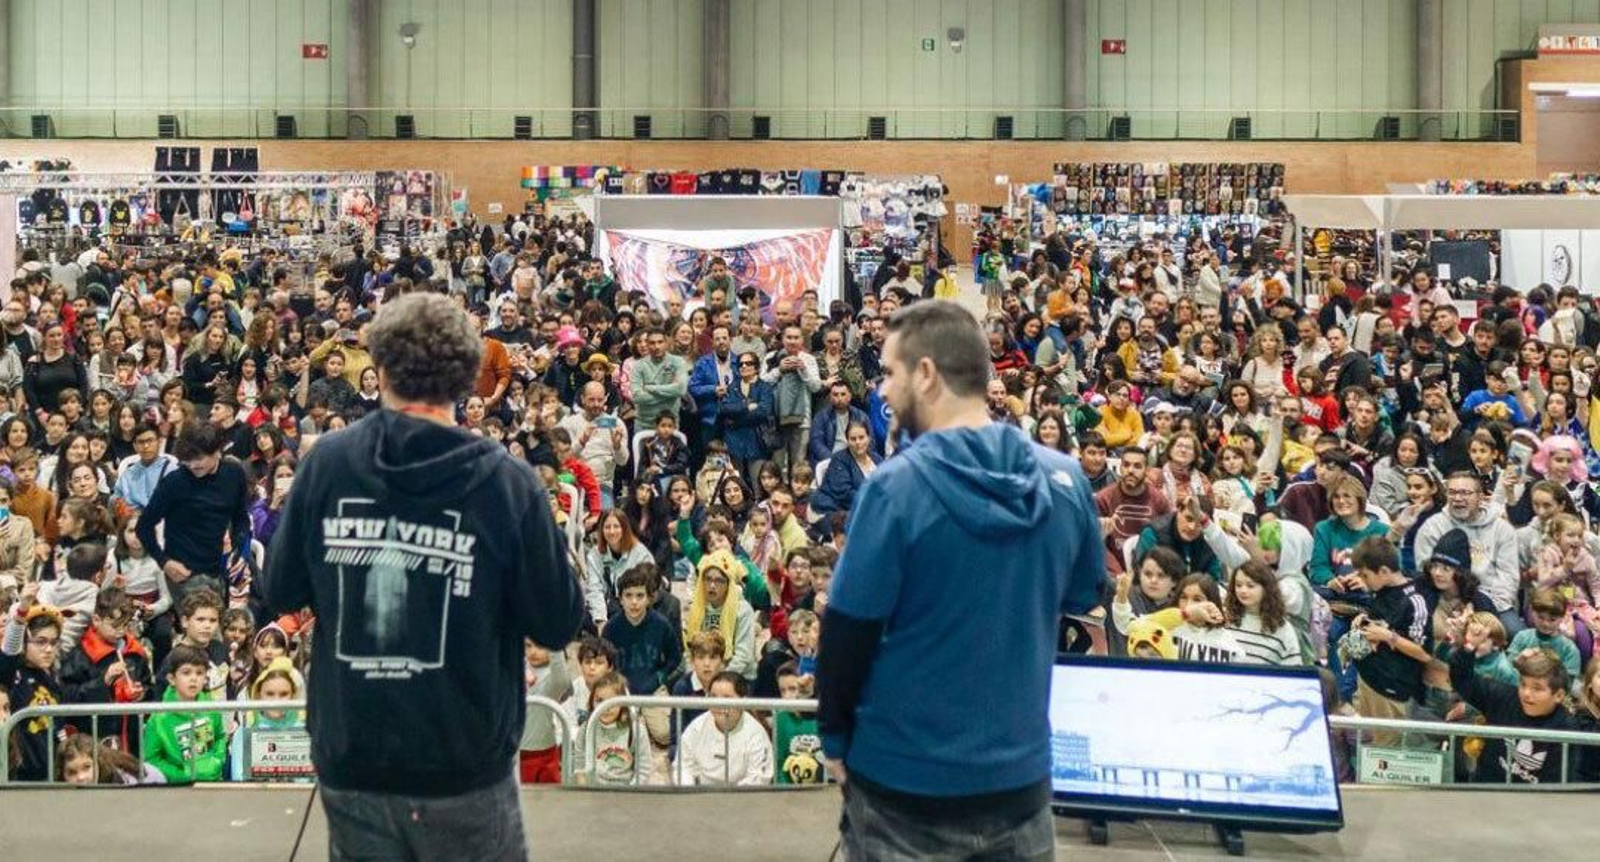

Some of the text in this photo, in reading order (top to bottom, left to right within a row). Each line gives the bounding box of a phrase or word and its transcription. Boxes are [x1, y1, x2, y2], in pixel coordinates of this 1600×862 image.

[323, 518, 476, 553] NEW YORK
[1371, 770, 1431, 783] ALQUILER
